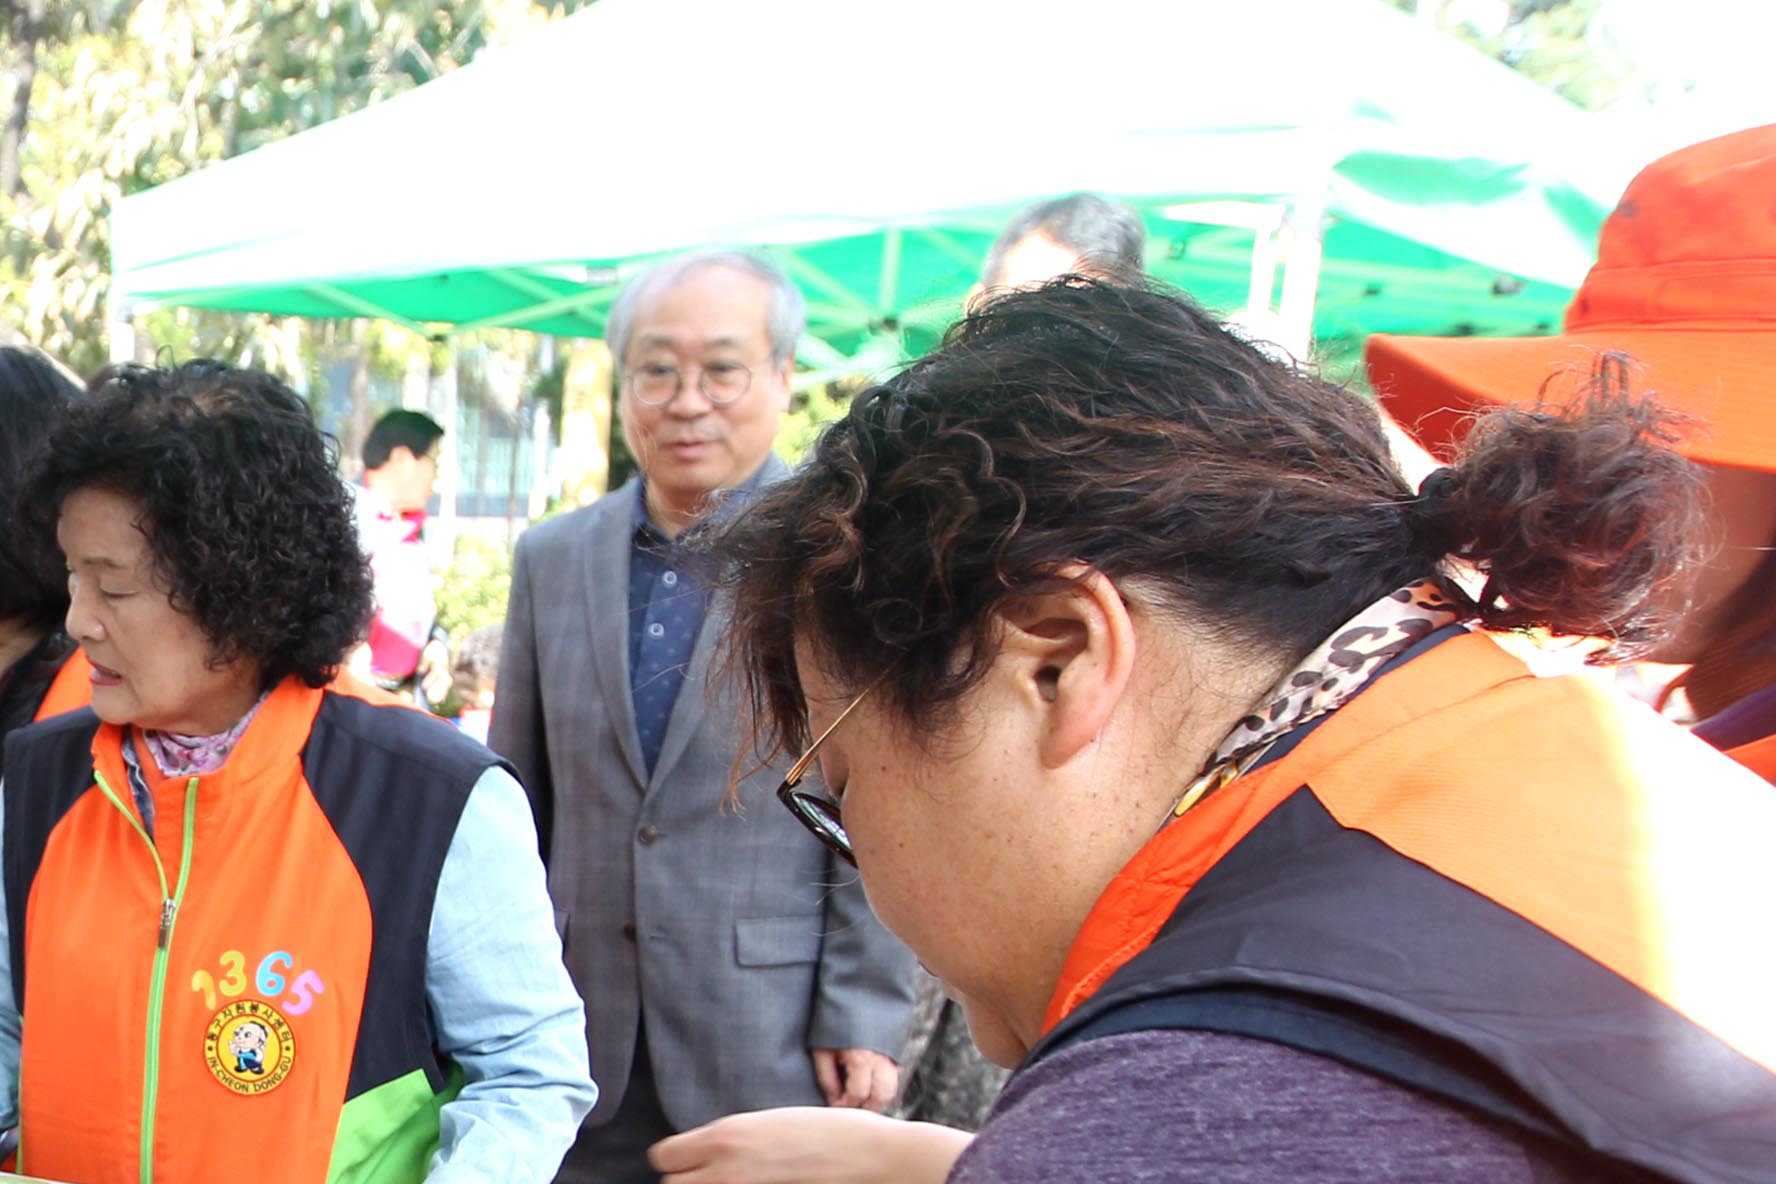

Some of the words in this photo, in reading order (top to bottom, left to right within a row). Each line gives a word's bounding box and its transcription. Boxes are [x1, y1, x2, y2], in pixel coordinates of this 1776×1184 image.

[191, 950, 326, 1015] 1365
[208, 1056, 250, 1093] IN-CHEON
[252, 1055, 292, 1093] DONG-GU
